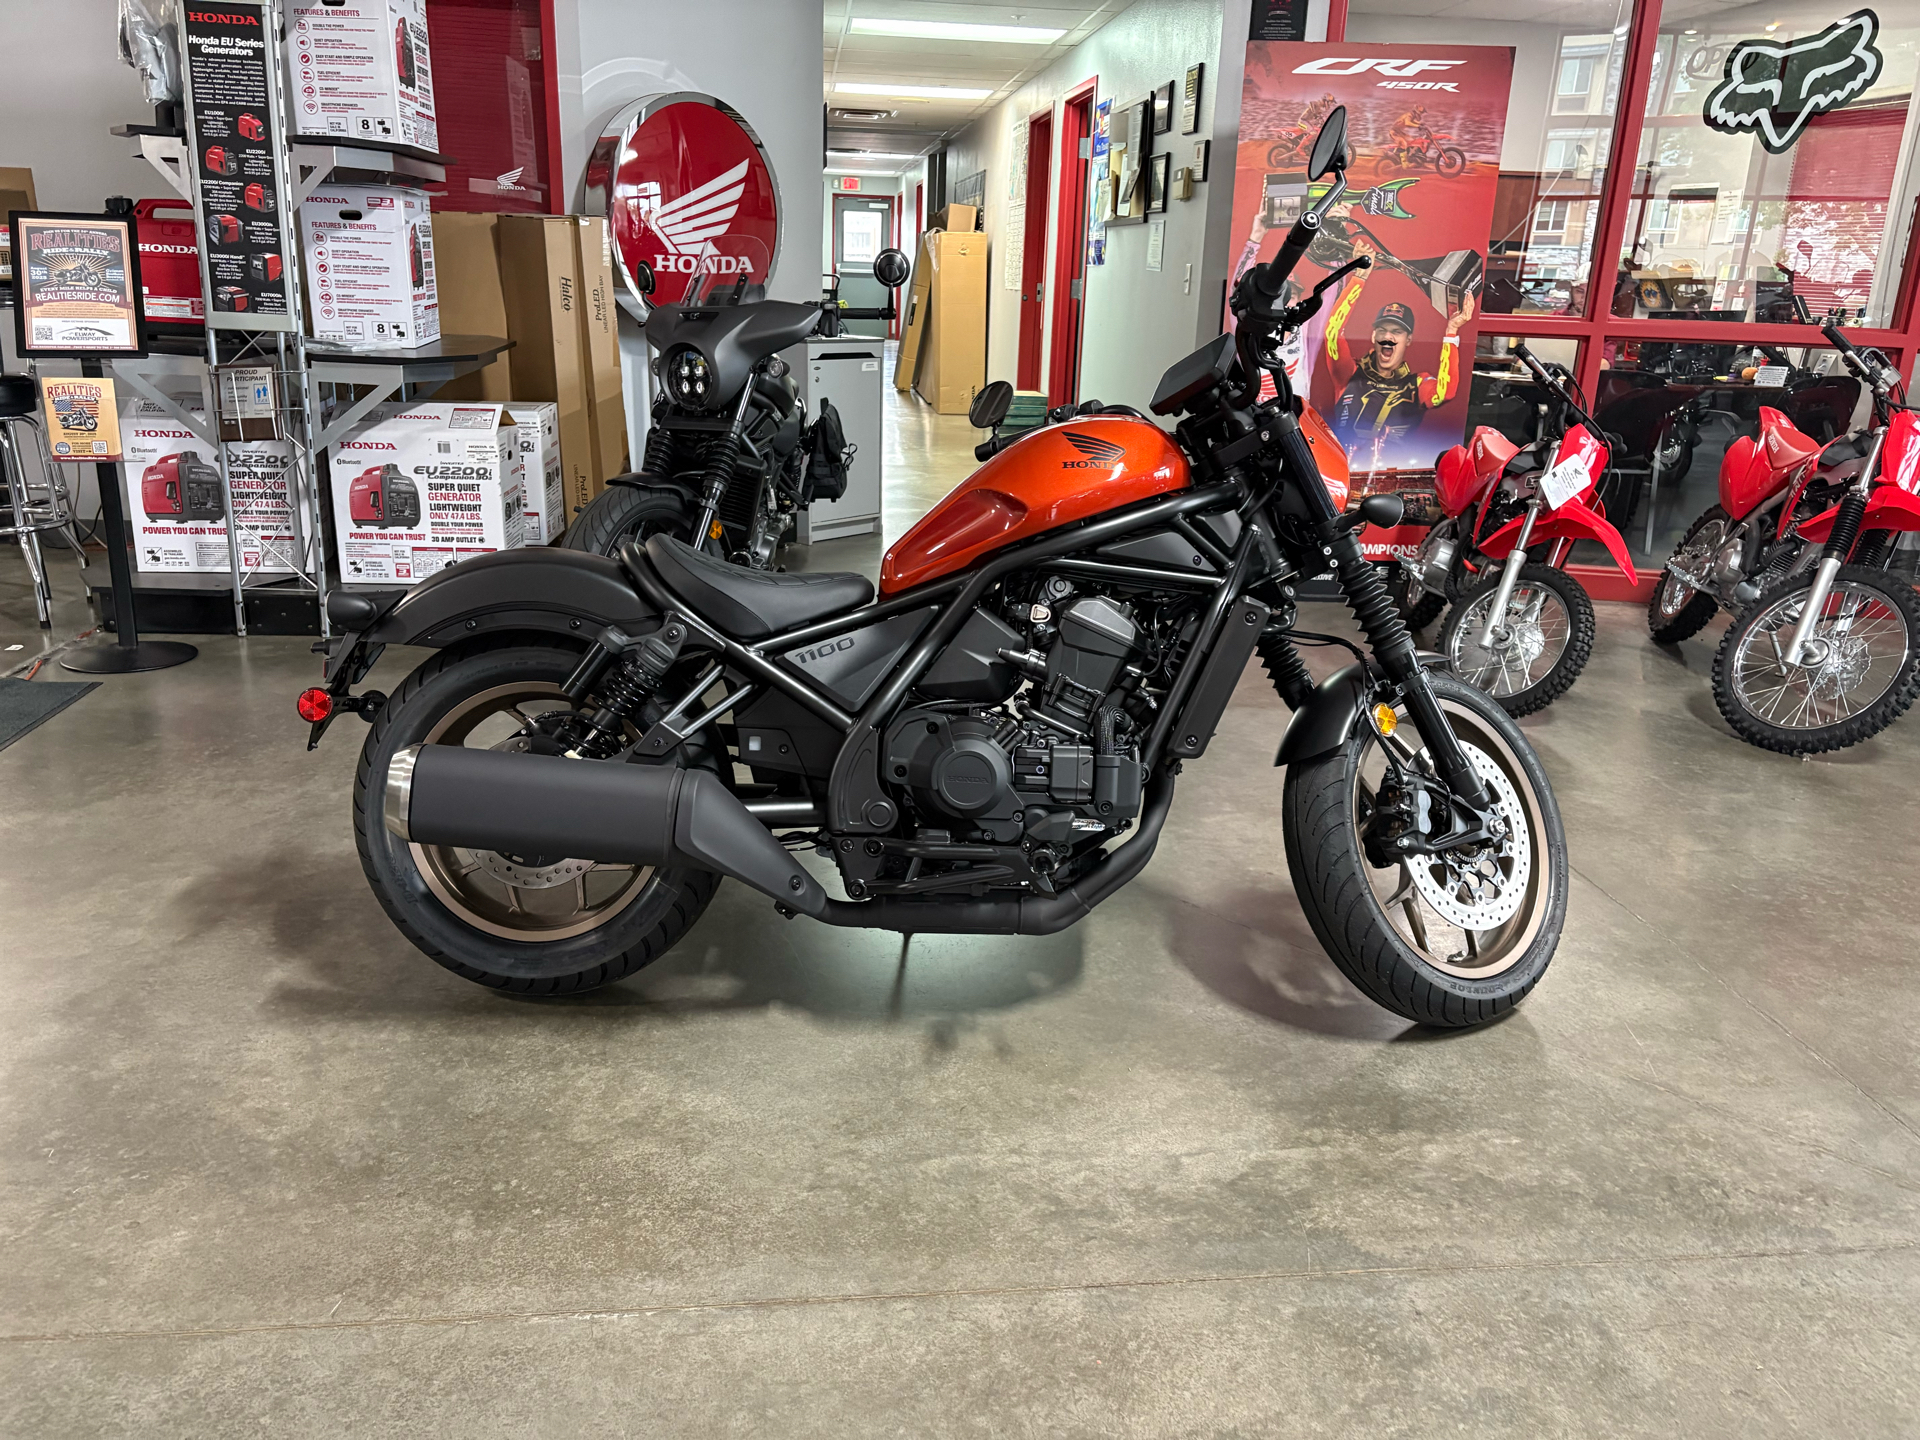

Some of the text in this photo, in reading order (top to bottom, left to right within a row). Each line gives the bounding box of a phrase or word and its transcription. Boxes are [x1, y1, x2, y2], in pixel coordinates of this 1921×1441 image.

[293, 8, 324, 16] FEATURES
[331, 9, 360, 17] BENEFITS
[188, 11, 260, 26] HONDA
[188, 35, 264, 48] Honda EU Series
[201, 45, 254, 56] Generators
[1291, 57, 1468, 77] CRF
[1376, 81, 1461, 93] 450R
[361, 119, 370, 130] 8
[305, 196, 349, 204] HONDA
[311, 221, 342, 229] FEATURES
[348, 223, 377, 231] BENEFITS
[30, 232, 120, 252] REALITIES
[74, 248, 109, 256] RALLY
[138, 243, 198, 255] HONDA
[654, 254, 754, 274] HONDA
[35, 291, 120, 303] REALITIESRIDE.COM
[561, 276, 573, 312] Halco
[593, 288, 603, 321] ProLED
[377, 323, 385, 334] 8
[47, 384, 102, 398] REALITIES
[134, 430, 195, 439] HONDA
[339, 441, 397, 451] HONDA
[1767, 434, 1779, 454] HONDA
[229, 471, 285, 480] SUPER QUIET
[413, 465, 493, 477] EU2200i
[230, 481, 287, 489] GENERATOR
[428, 482, 481, 492] SUPER QUIET
[580, 475, 589, 505] ProLED
[232, 491, 287, 500] LIGHTWEIGHT
[428, 492, 482, 502] GENERATOR
[232, 500, 288, 508] ONLY 47.4 LBS.
[429, 503, 482, 512] LIGHTWEIGHT
[429, 512, 482, 521] ONLY 47.4 LBS.
[142, 526, 227, 535] POWER YOU CAN TRUS
[349, 532, 375, 540] POWER
[389, 533, 404, 541] CAN
[405, 533, 426, 541] TRUST
[1361, 543, 1419, 556] AMPIONS
[795, 636, 855, 664] 1100
[946, 775, 989, 785] HONDA
[1449, 982, 1496, 995] DUNLOP
